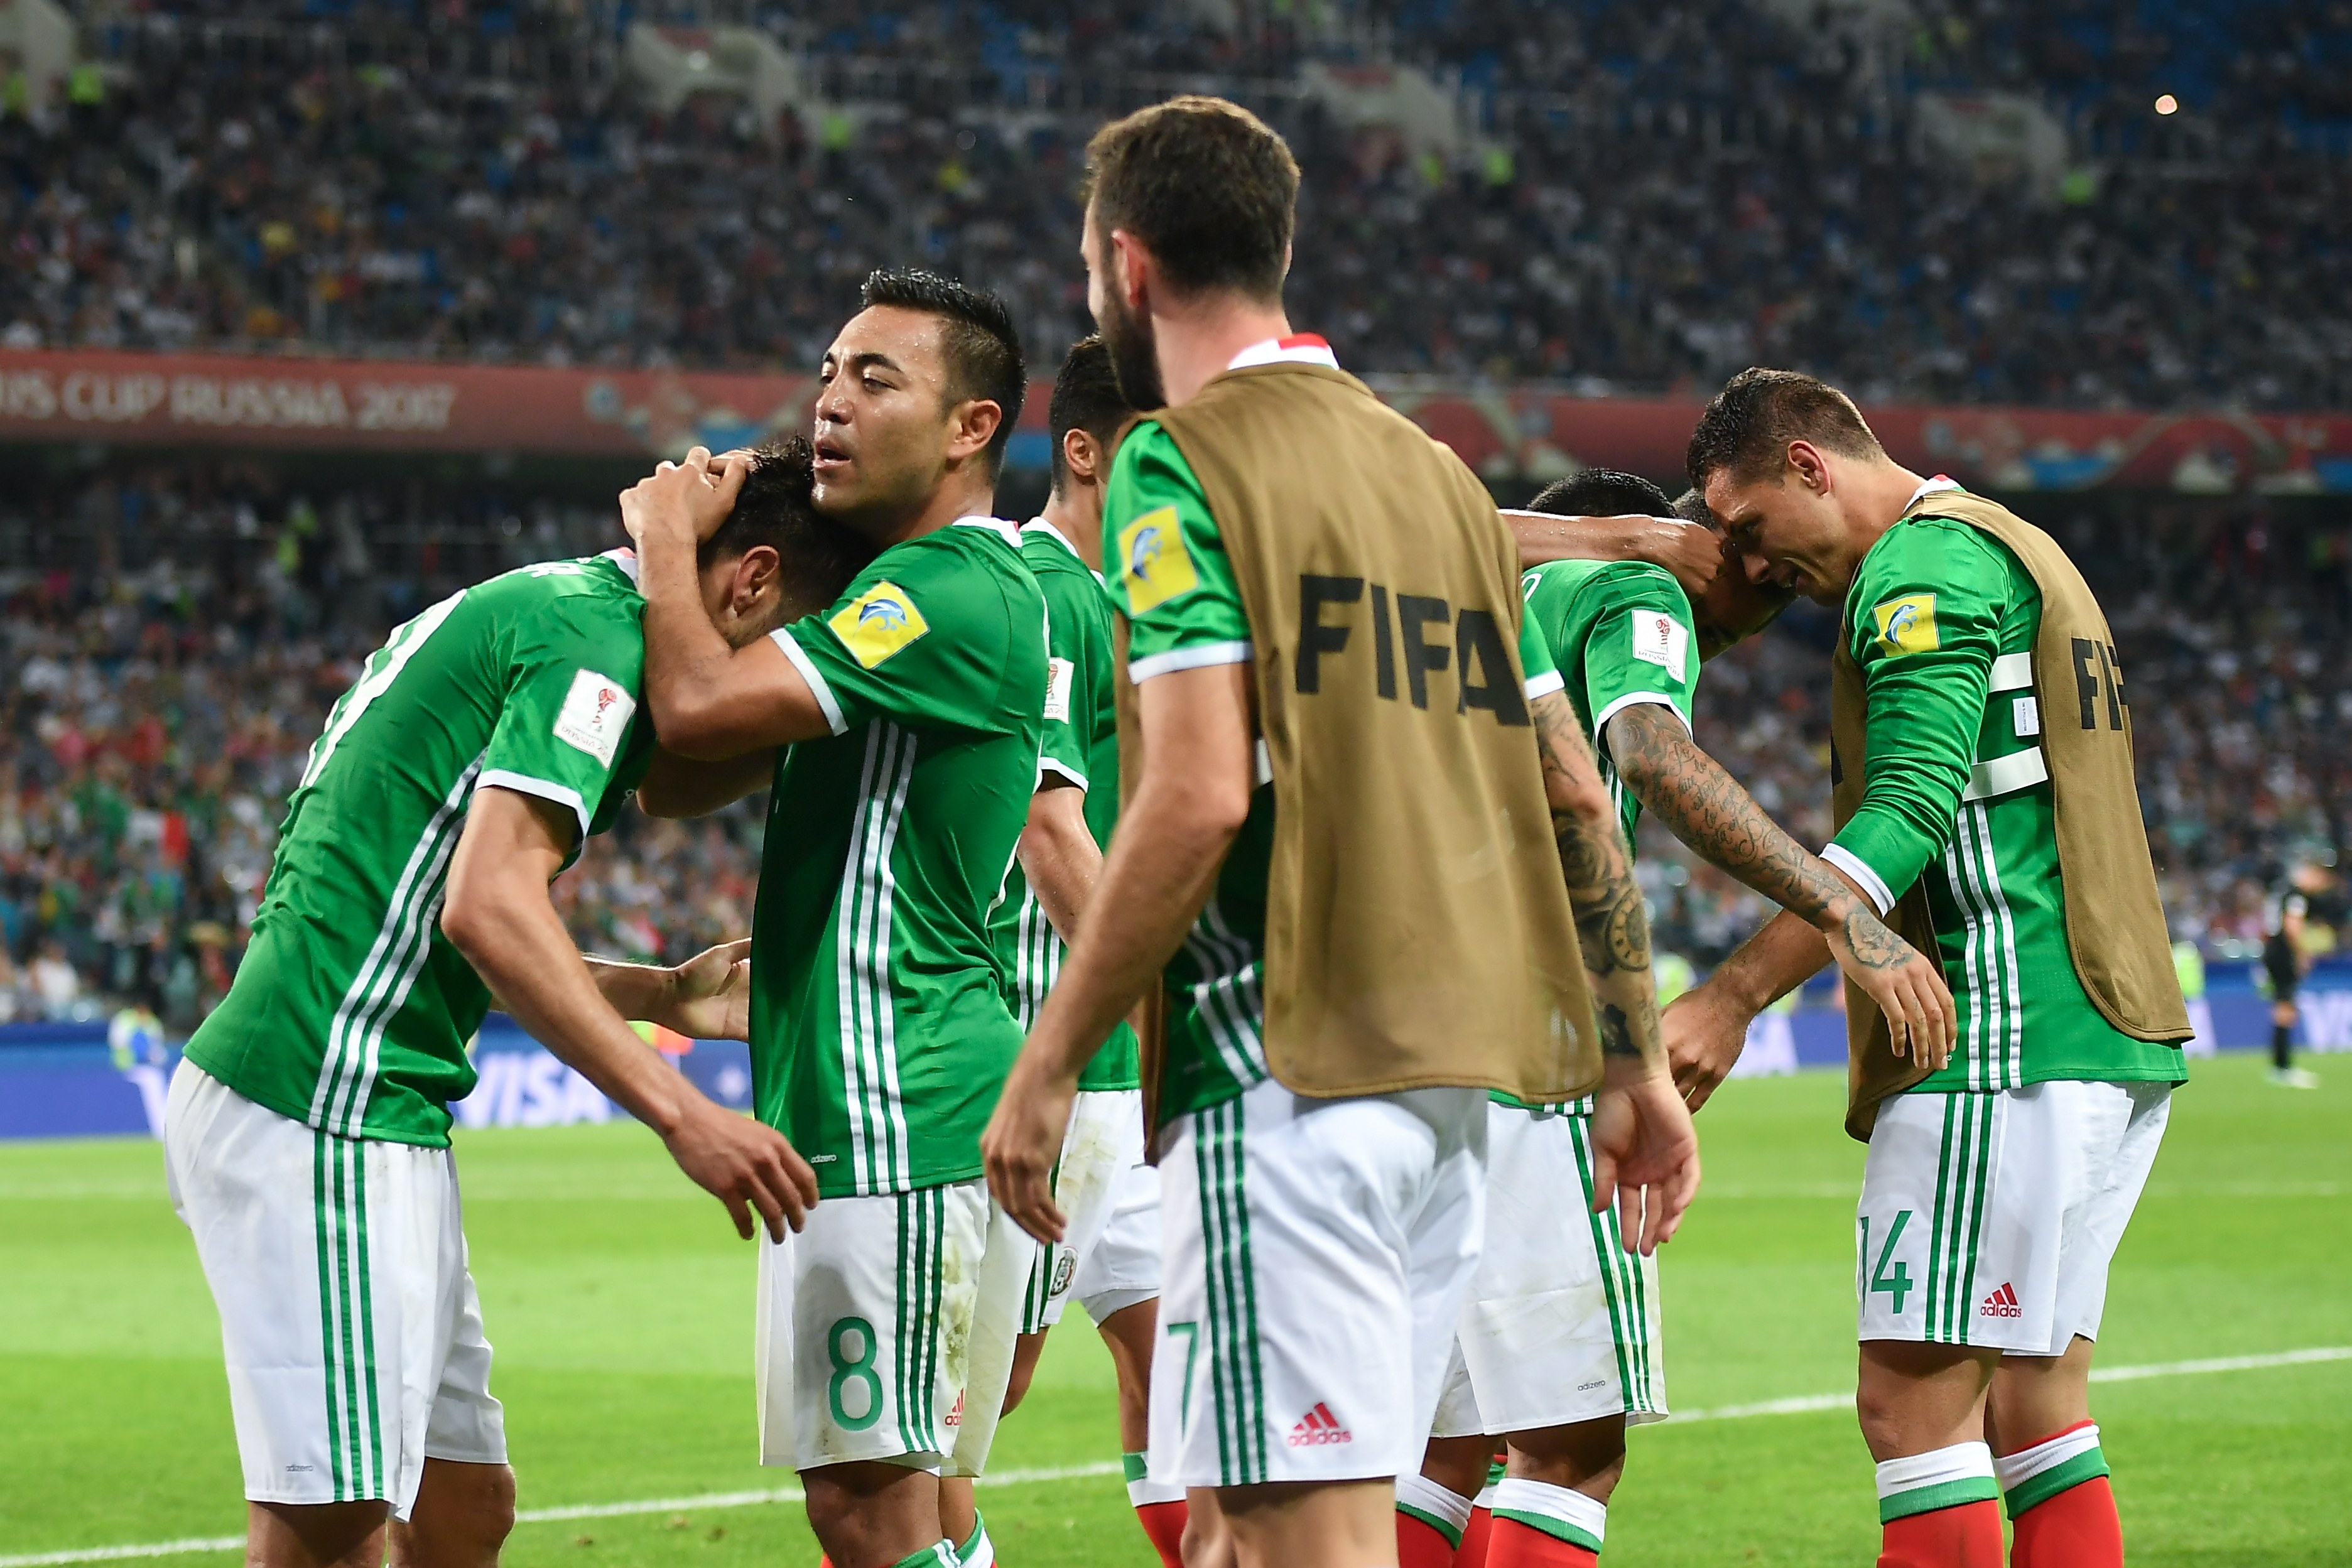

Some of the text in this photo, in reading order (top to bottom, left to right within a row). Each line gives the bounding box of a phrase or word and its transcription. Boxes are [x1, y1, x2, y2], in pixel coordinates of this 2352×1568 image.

[64, 370, 166, 421] CUP
[168, 375, 349, 426] RUSSIA
[355, 381, 457, 431] 2017
[1296, 575, 1531, 726] FIFA
[457, 1051, 612, 1129] VISA
[1860, 1210, 1914, 1317] 14
[1980, 1304, 2022, 1318] adidas
[828, 1316, 884, 1432] 8
[1167, 1321, 1198, 1442] 7
[1577, 1380, 1606, 1392] adizero
[1287, 1427, 1352, 1447] adidas
